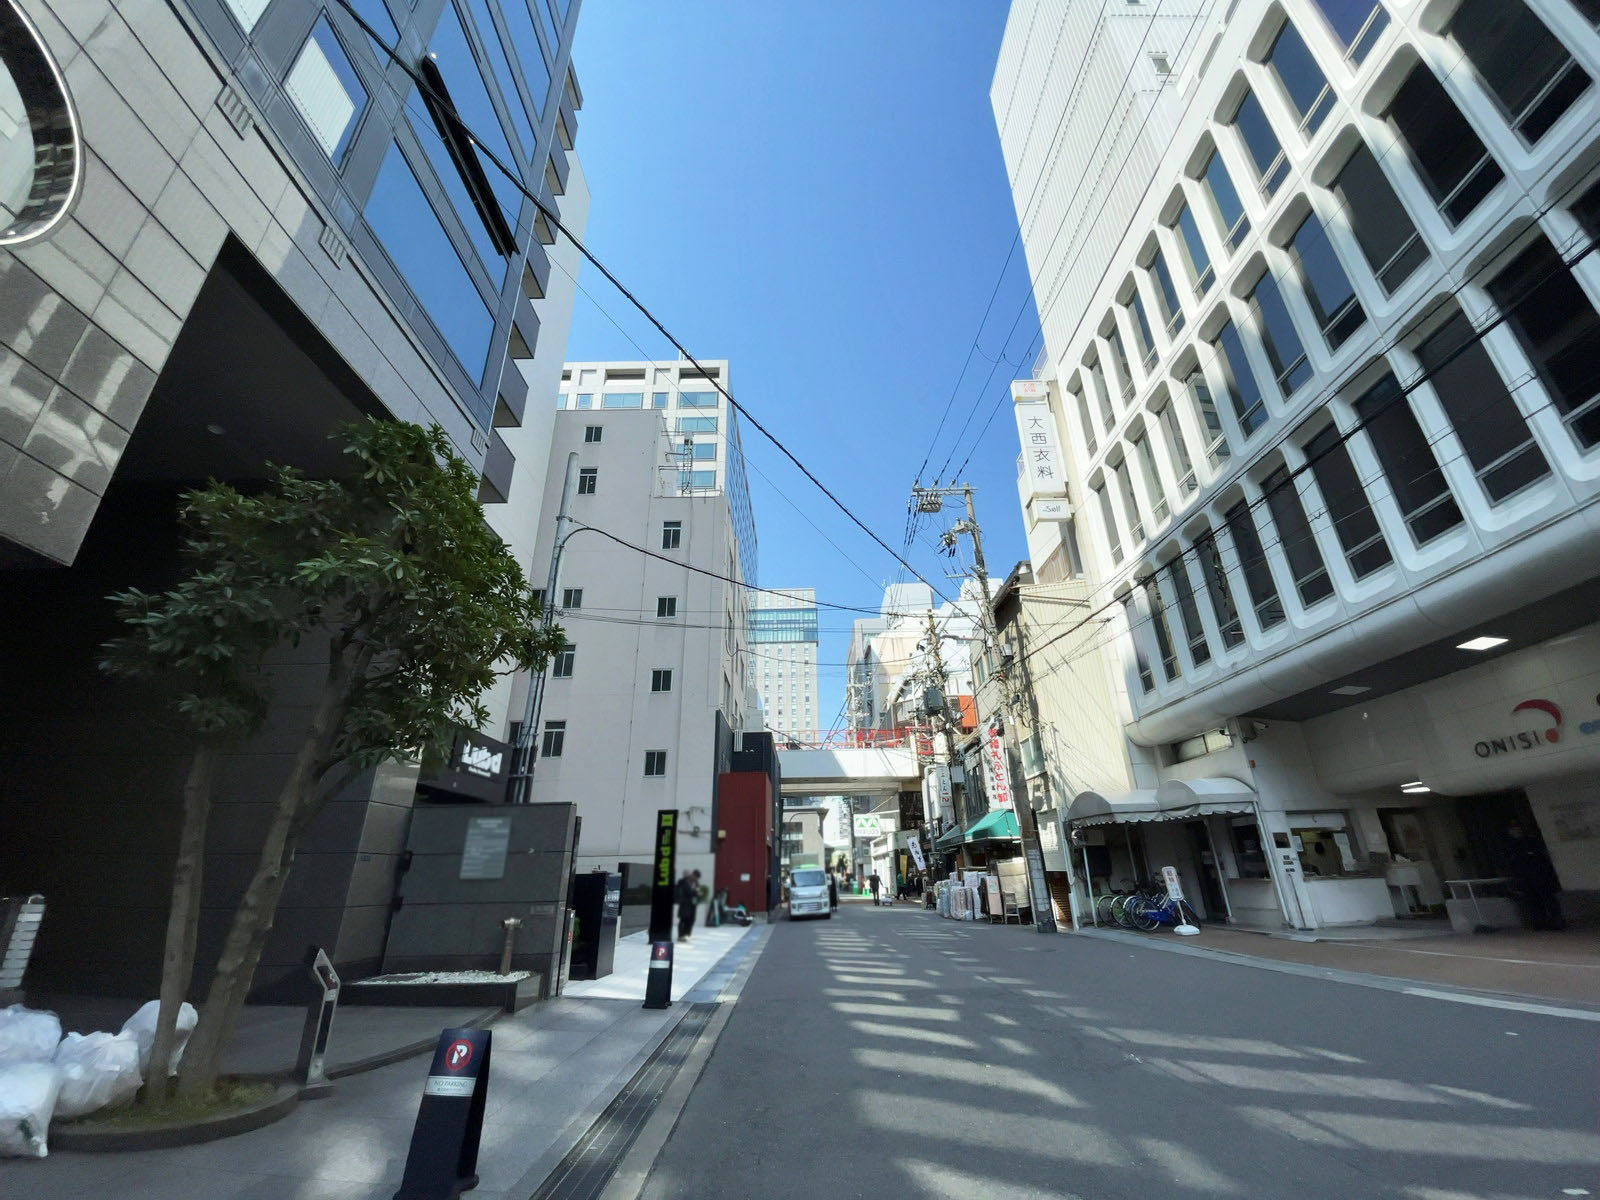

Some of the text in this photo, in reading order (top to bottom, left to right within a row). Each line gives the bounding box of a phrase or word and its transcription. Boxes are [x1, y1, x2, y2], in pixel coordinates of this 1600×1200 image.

[1027, 416, 1054, 479] 大西衣料
[1474, 730, 1541, 758] ONISI
